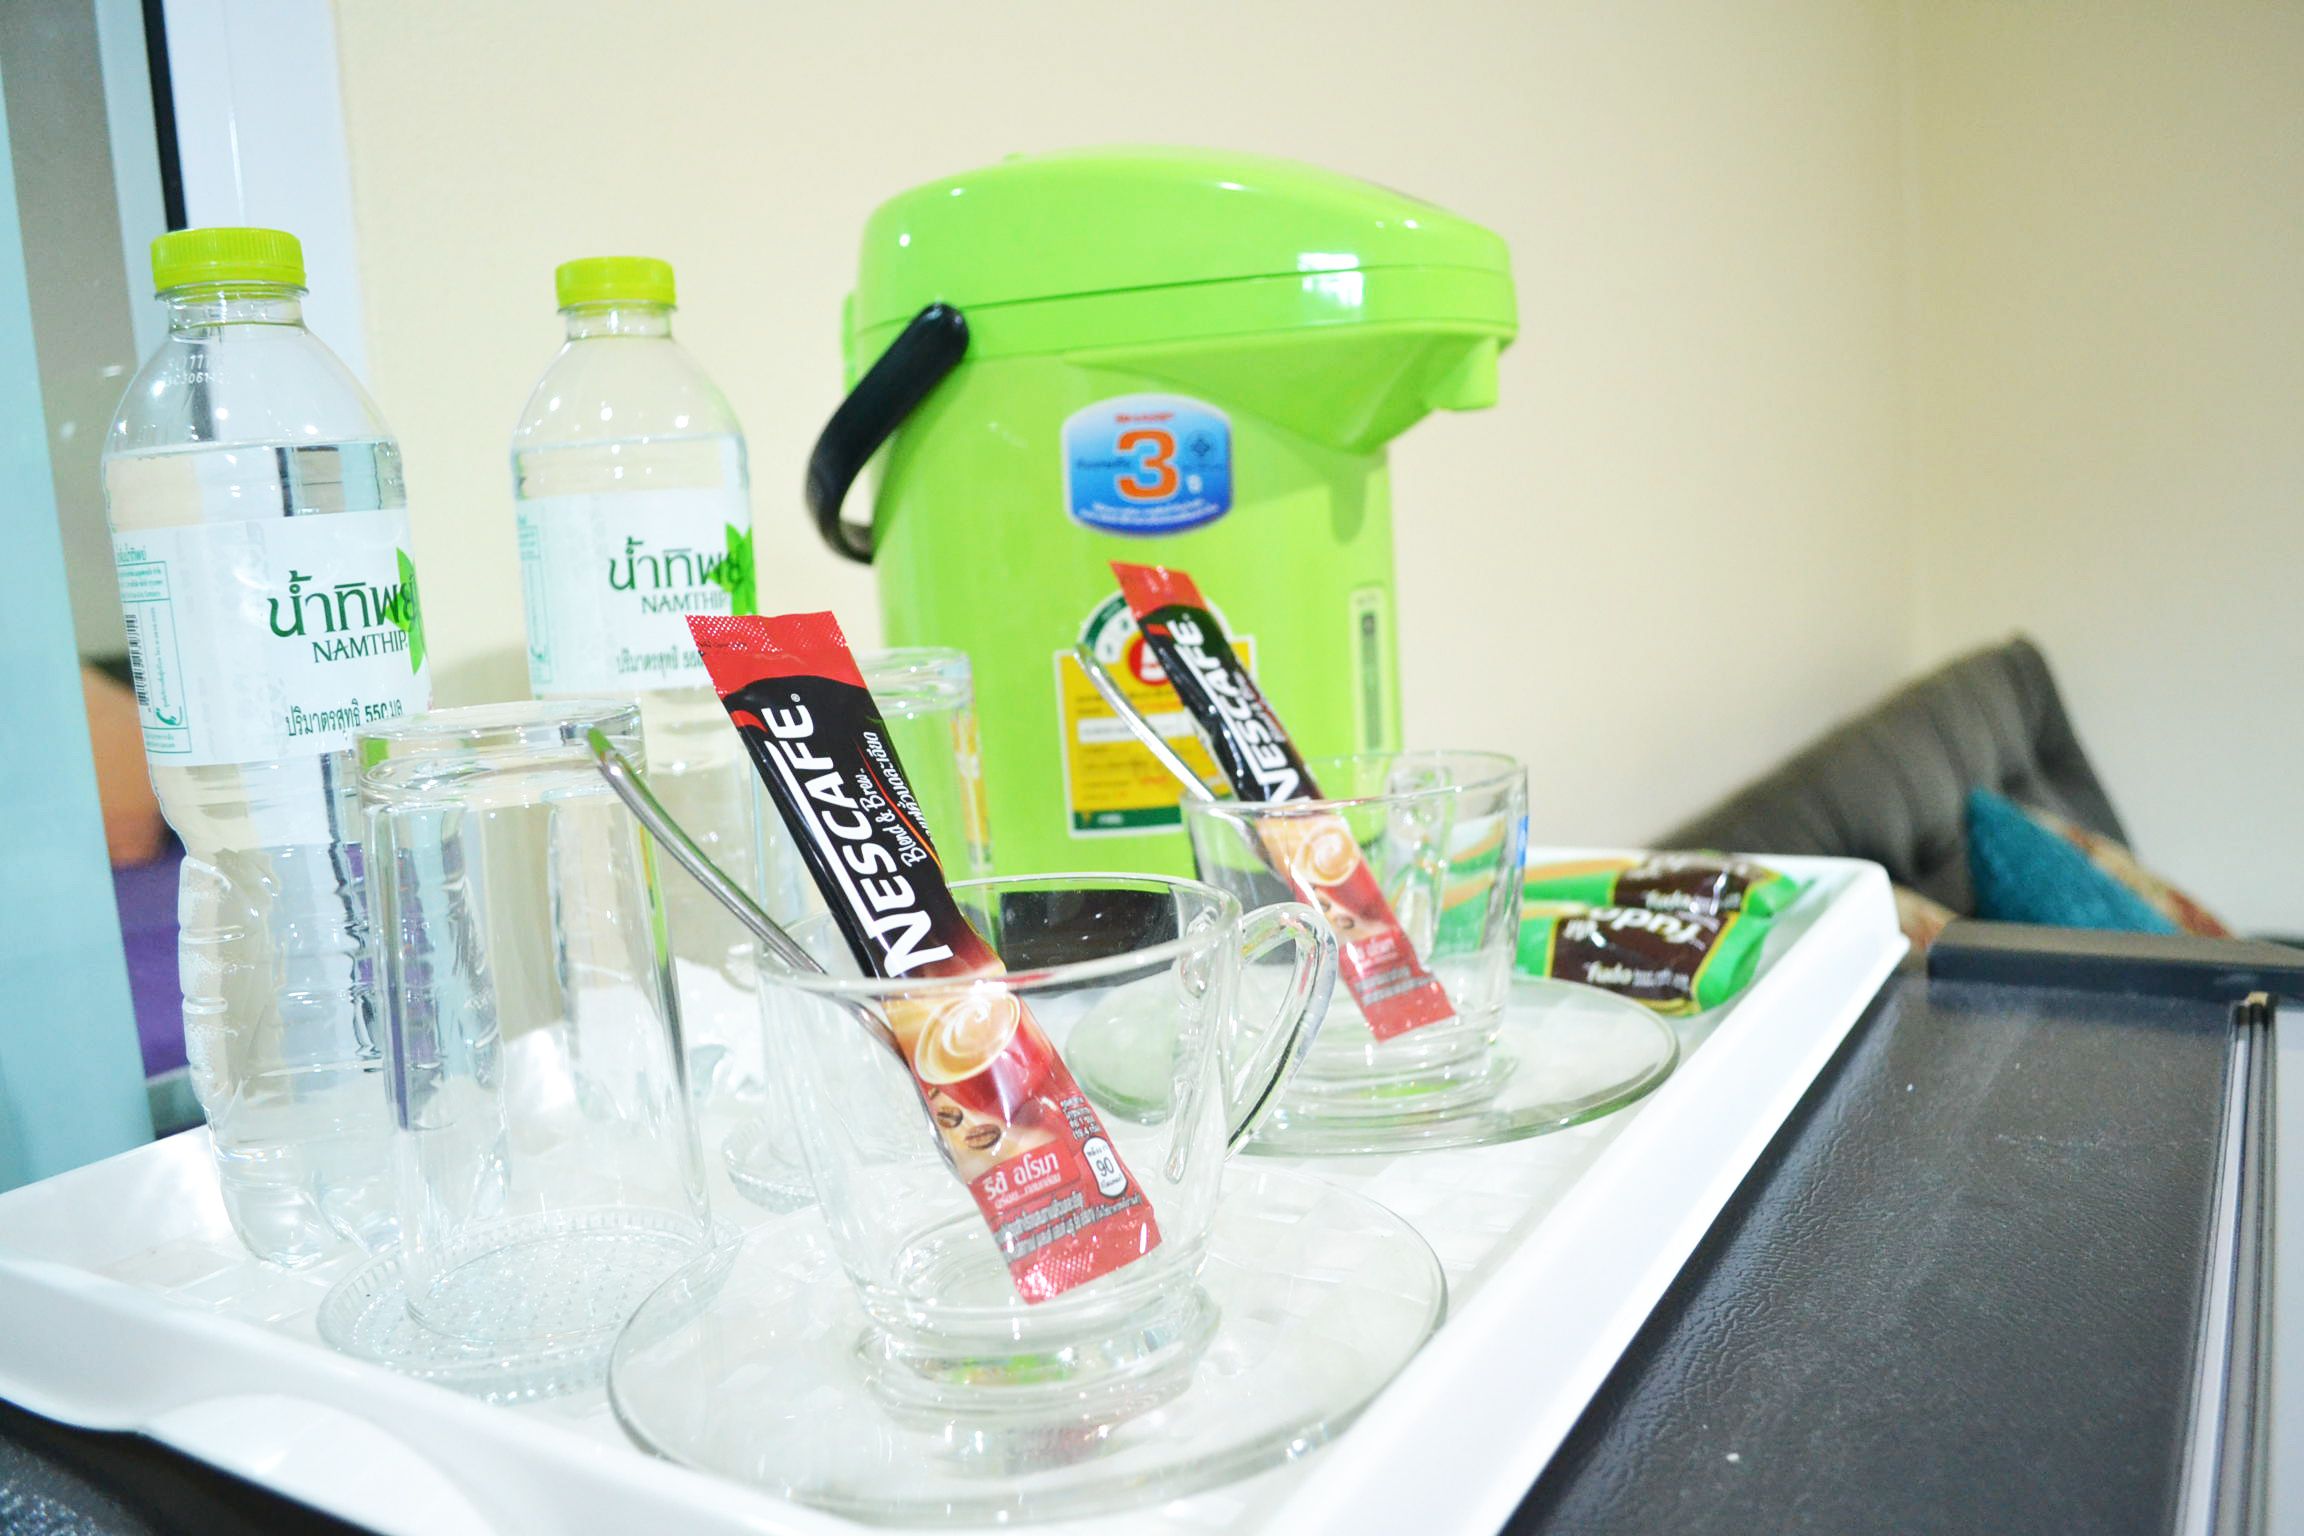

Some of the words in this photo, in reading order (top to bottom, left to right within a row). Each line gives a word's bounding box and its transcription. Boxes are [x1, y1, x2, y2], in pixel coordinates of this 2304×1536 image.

[1117, 430, 1178, 499] 3
[312, 629, 407, 663] NAMTHIP
[855, 772, 886, 812] Brew
[875, 809, 894, 824] &
[884, 823, 928, 868] Blend
[1096, 1157, 1116, 1176] 90
